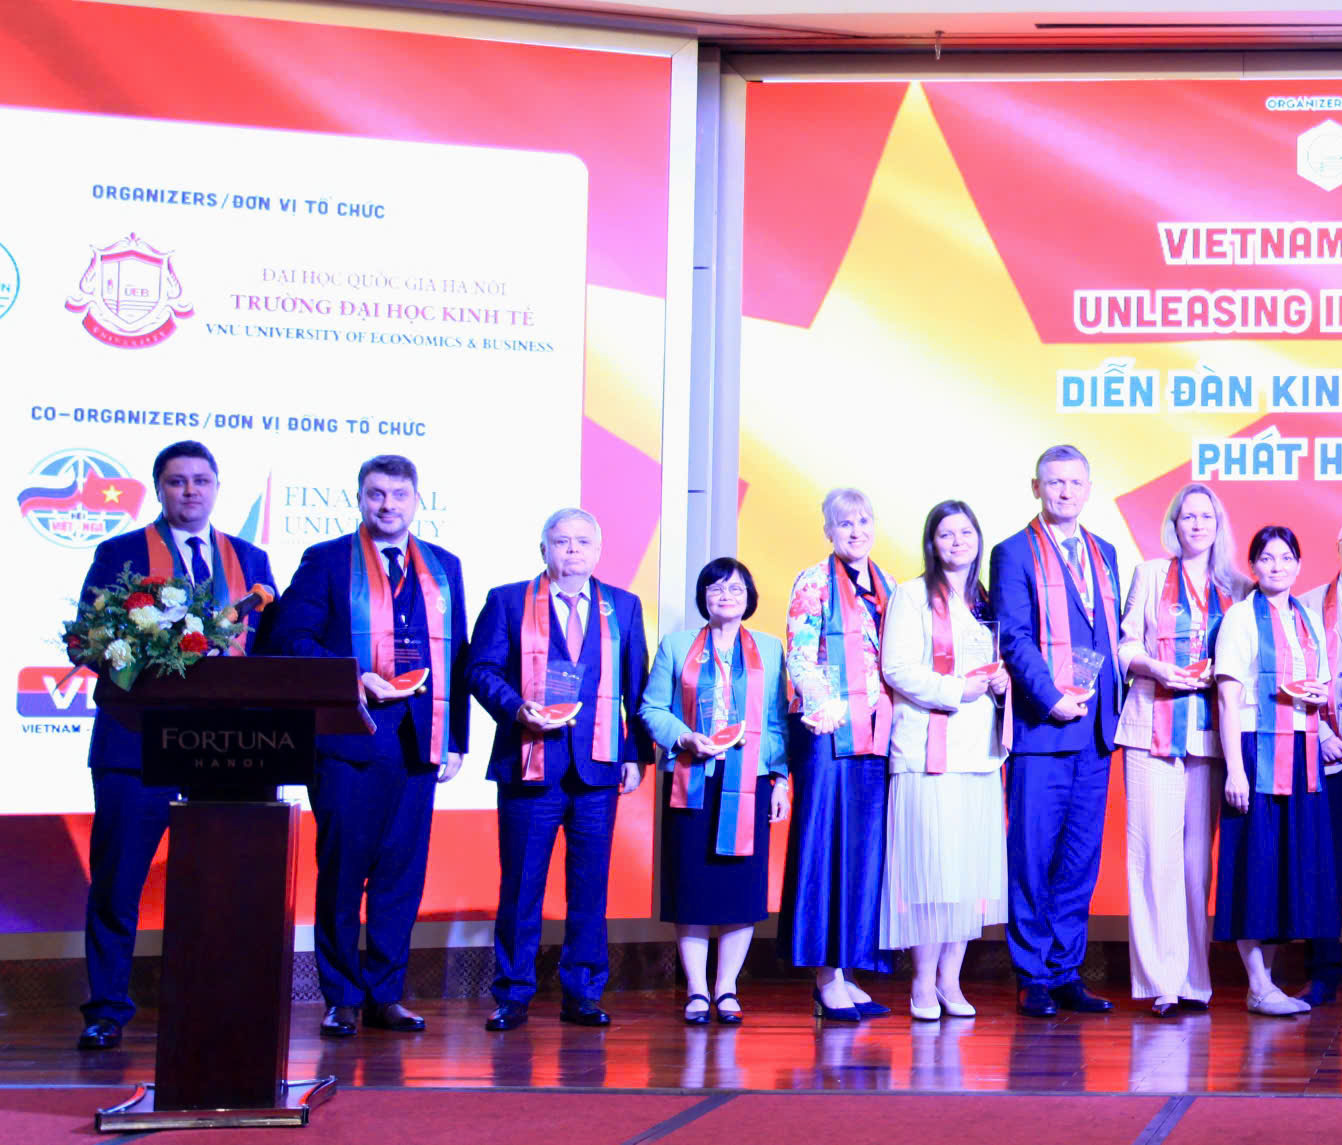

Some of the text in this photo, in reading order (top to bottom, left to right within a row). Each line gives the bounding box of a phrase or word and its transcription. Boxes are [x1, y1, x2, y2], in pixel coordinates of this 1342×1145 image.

[442, 306, 499, 325] KINH
[1079, 294, 1306, 327] UNLEASING
[206, 322, 554, 353] VNU UNIVERSITY OF ECONOMICS & BUSINESS
[1062, 363, 1154, 407] DIỄN
[1170, 364, 1252, 407] ĐÀN
[1198, 433, 1303, 475] PHÁT
[22, 723, 81, 734] VIETNAM
[162, 727, 296, 753] FORTUNA
[195, 759, 264, 768] HANOI
